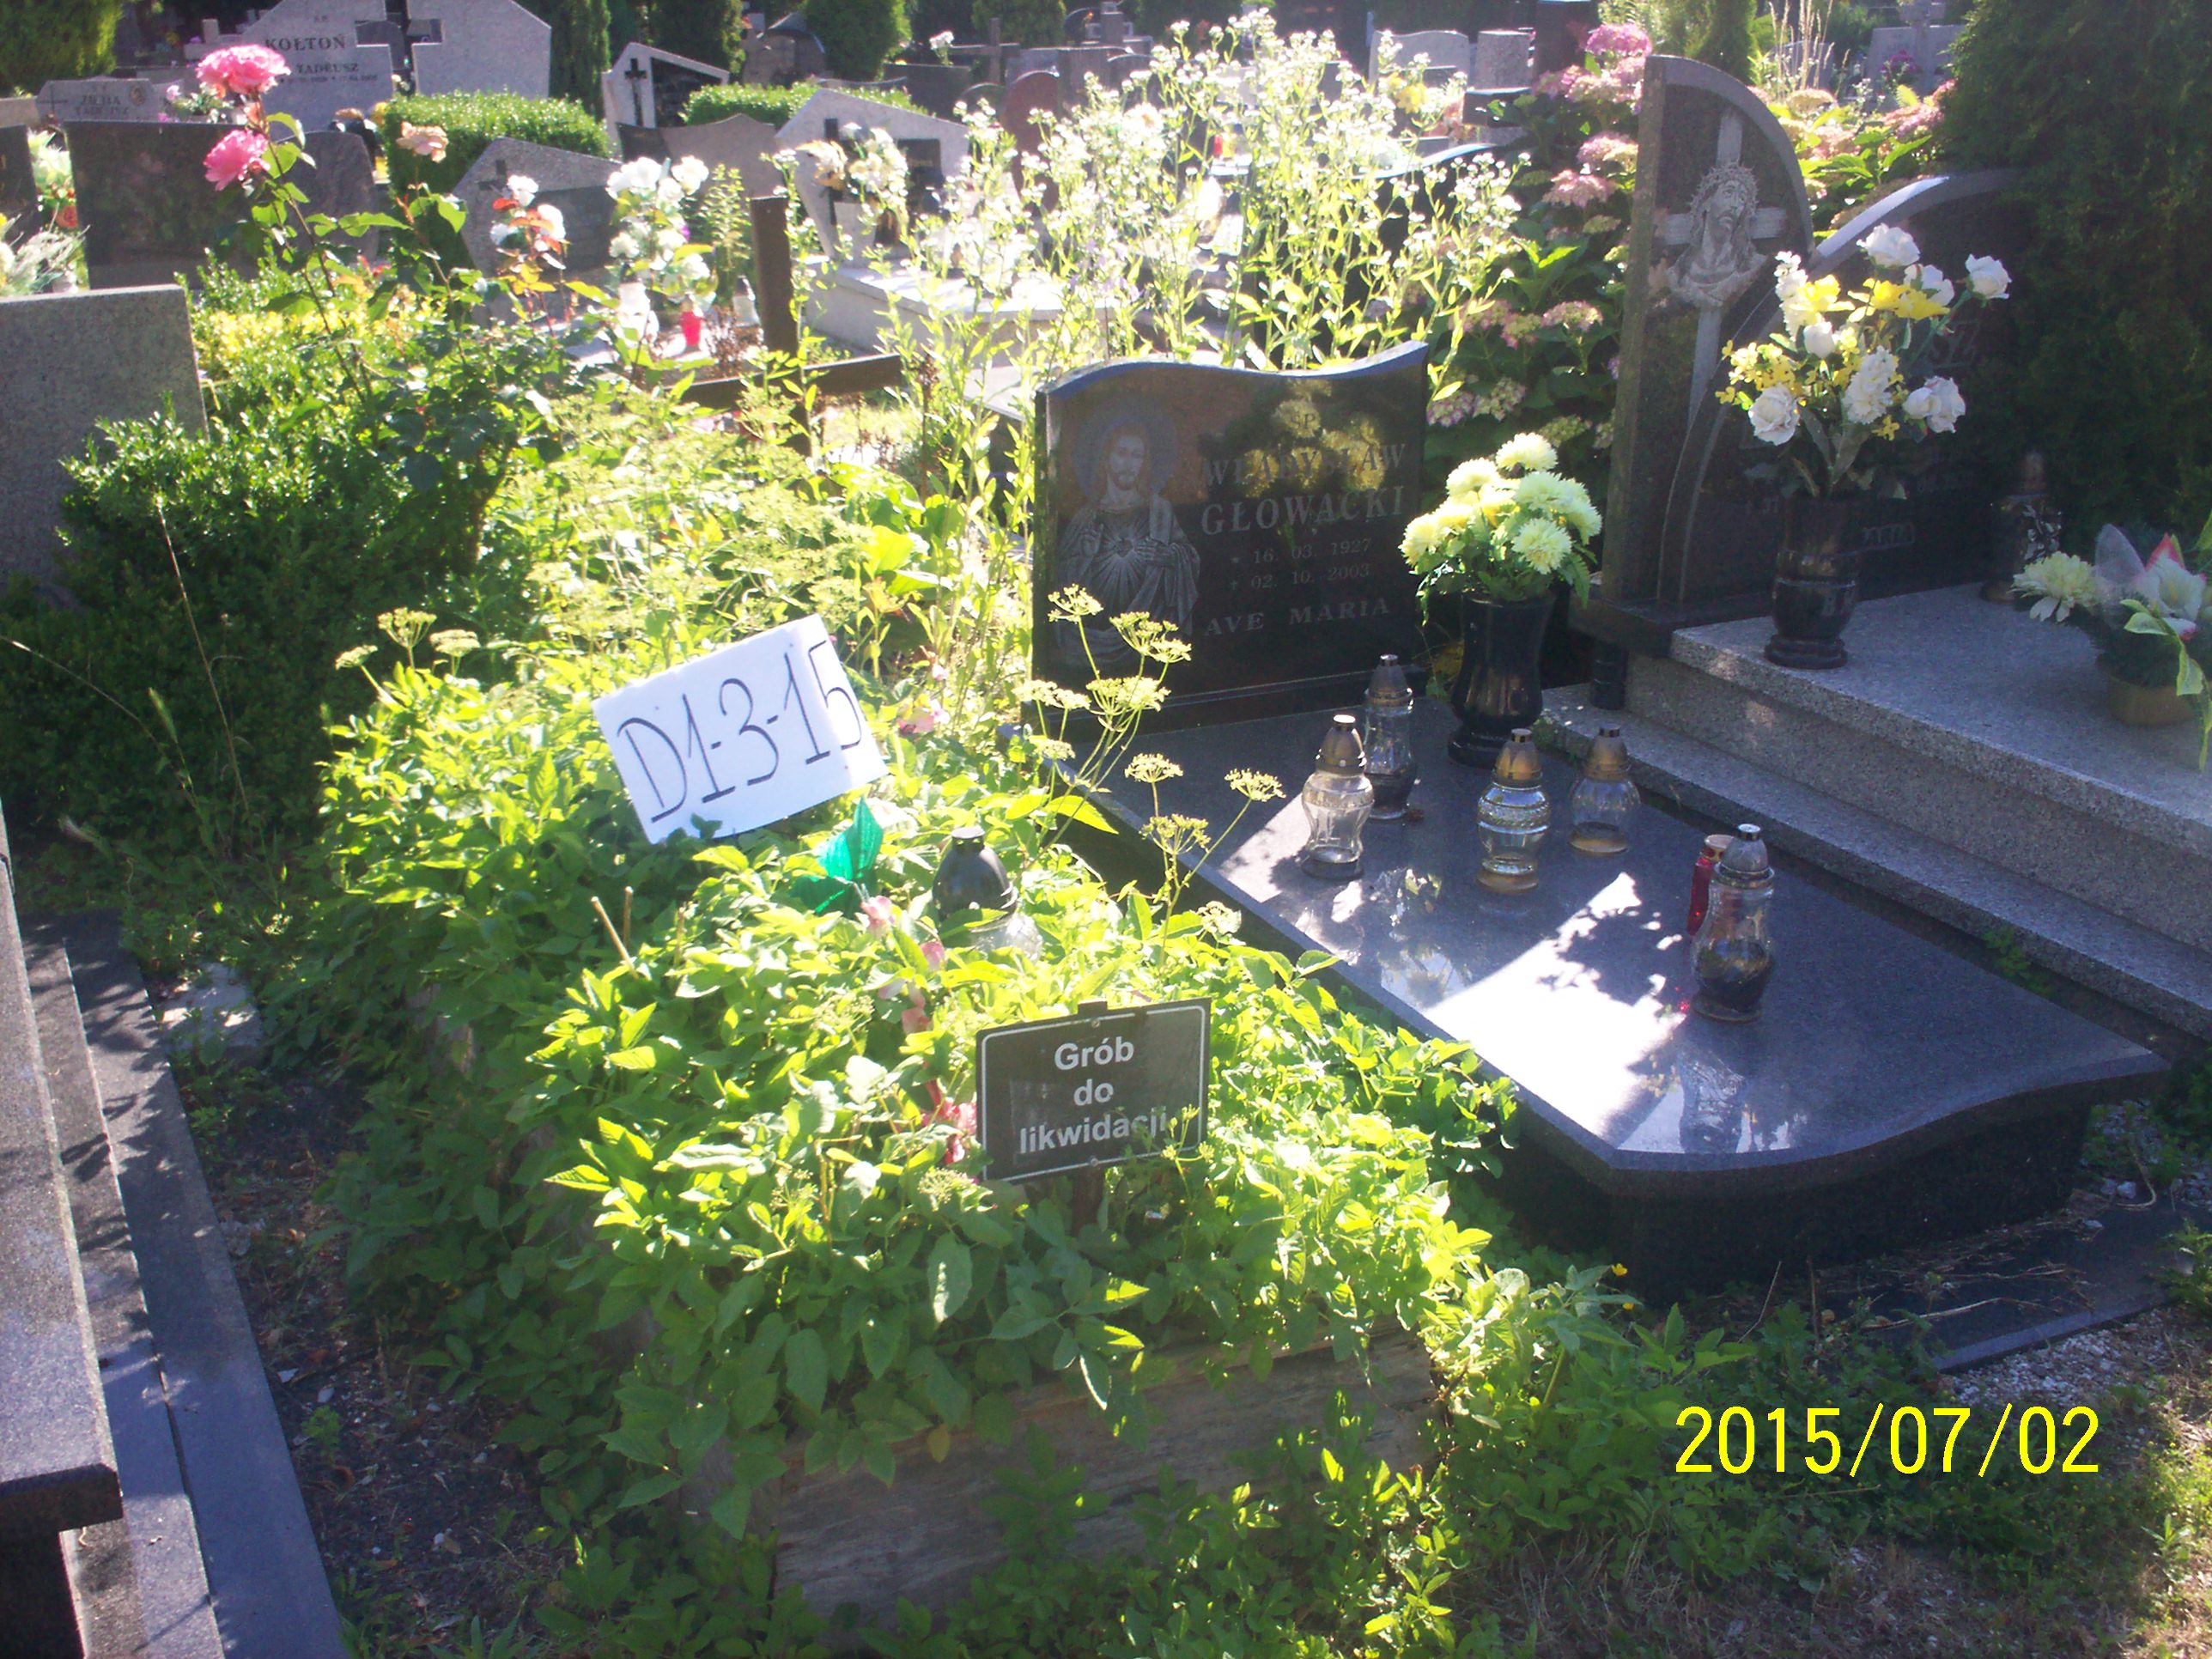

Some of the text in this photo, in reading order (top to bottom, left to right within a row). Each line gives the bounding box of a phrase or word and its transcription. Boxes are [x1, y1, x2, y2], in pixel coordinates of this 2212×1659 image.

[1202, 485, 1404, 536] GŁOWACKI
[1331, 538, 1372, 556] 1927
[1204, 597, 1389, 636] AVE MARIA
[617, 640, 863, 824] D1-3-15
[1054, 1036, 1134, 1071] Grób
[1073, 1079, 1114, 1106] do
[1019, 1105, 1167, 1154] likwidacji
